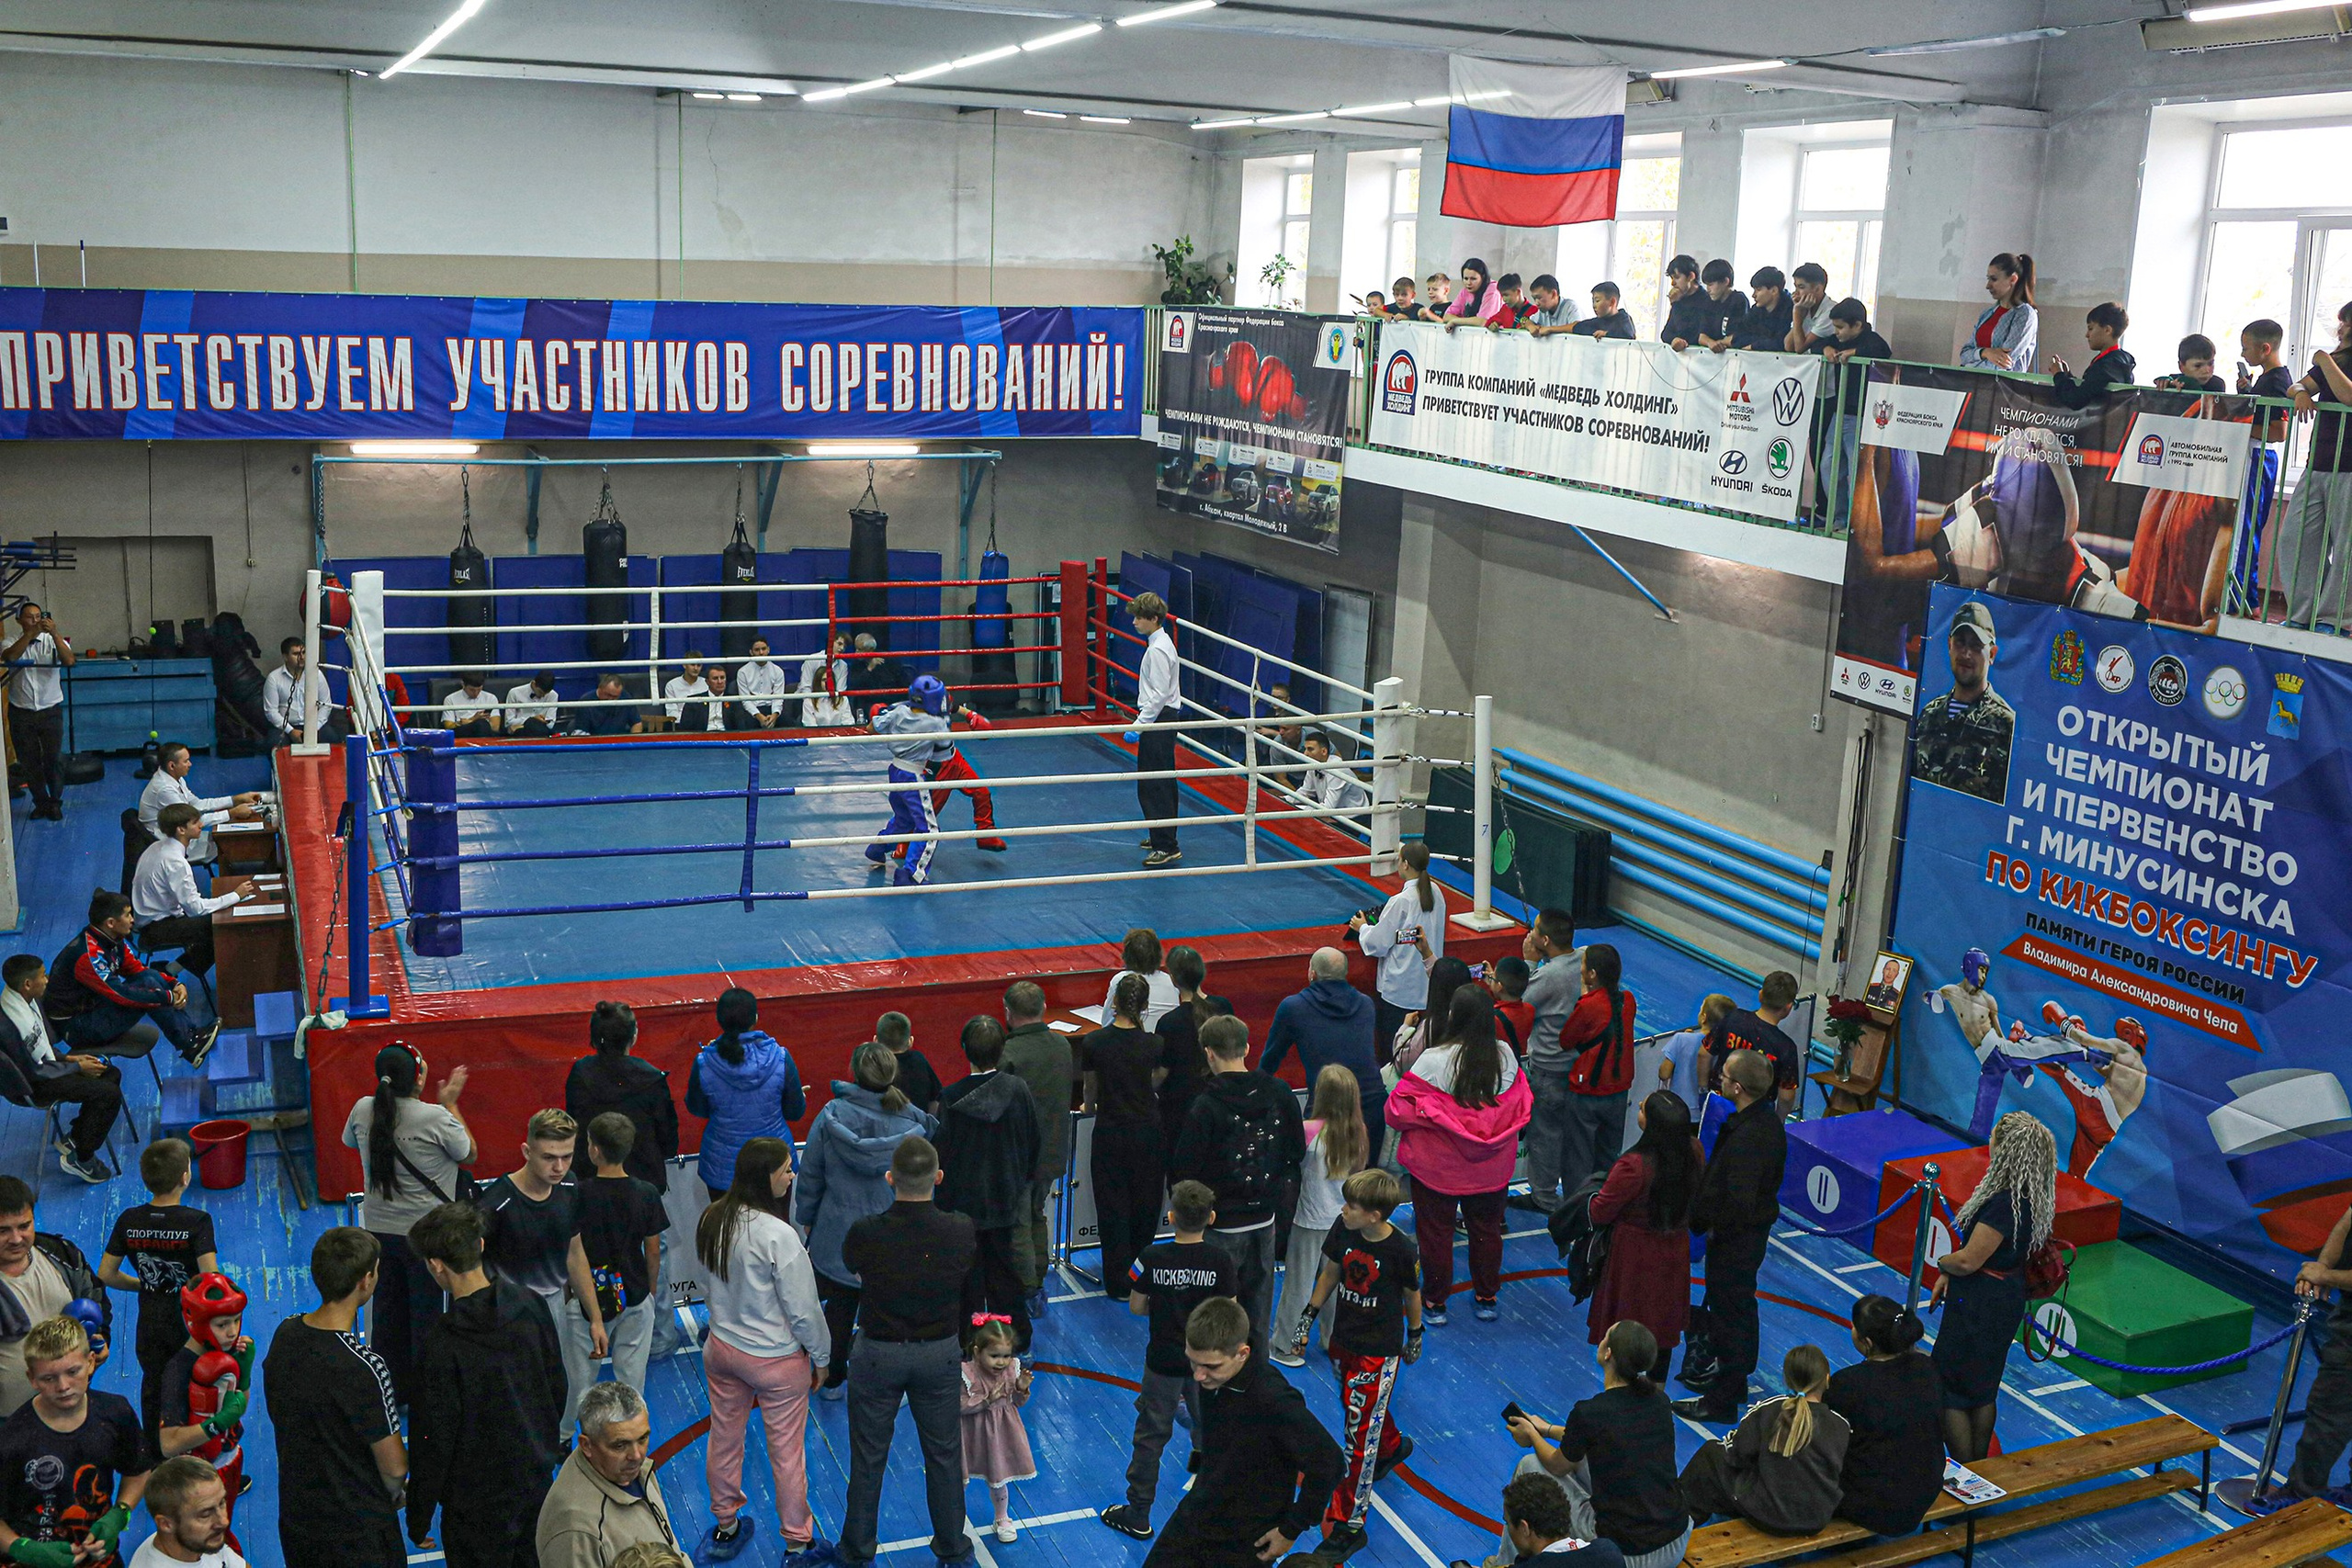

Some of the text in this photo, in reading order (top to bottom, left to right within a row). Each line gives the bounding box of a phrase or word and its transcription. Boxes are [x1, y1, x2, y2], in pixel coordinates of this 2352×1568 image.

[0, 331, 1126, 413] ПРИВЕТСТВУЕМ УЧАСТНИКОВ СОРЕВНОВАНИЙ!
[1425, 369, 1679, 415] ГРУППА КОМПАНИЙ «МЕДВЕДЬ ХОЛДИНГ»
[1725, 404, 1755, 415] MITSUBISHI
[1729, 413, 1751, 423] MOTORS
[1897, 411, 1922, 419] ФЕДЕРАЦИЯ
[2000, 406, 2080, 428] ЧЕМПИОНАМИ
[1204, 414, 1212, 424] НЕ
[1213, 415, 1251, 434] РОЖДАЮТСЯ,
[1253, 423, 1295, 441] ЧЕМПИОНАМИ
[1296, 430, 1343, 448] СТАНОВЯТСЯ!
[1422, 395, 1711, 454] ПРИВЕТСТВУЕТ УЧАСТНИКОВ СОРЕВНОВАНИЙ!
[1896, 419, 1931, 427] КРАСНОЯРСКОГО
[1994, 424, 2077, 450] НЕ РОЖДАЮТСЯ,
[2014, 446, 2084, 467] СТАНОВЯТСЯ!
[2169, 450, 2228, 463] ГРУППА КОМПАНИЙ
[2171, 442, 2222, 454] АВТОМОБИЛЬНАЯ
[1711, 476, 1753, 492] HYUNDAI
[1761, 483, 1792, 498] ŠKODA
[1875, 689, 1896, 698] HYUNDAI
[2056, 704, 2271, 788] ОТКРЫТЫЙ
[2046, 741, 2275, 833] ЧЕМПИОНАТ
[1482, 824, 1488, 836] 7
[2021, 779, 2300, 888] И ПЕРВЕНСТВО
[2005, 815, 2297, 937] Г. МИНУСИНСКА
[1984, 849, 2320, 990] ПО КИКБОКСИНГУ
[2024, 911, 2246, 1007] ПАМЯТИ ГЕРОЯ РОССИИ
[2022, 941, 2240, 1035] Владимира Александровича Чепа
[127, 1229, 189, 1240] СПОРТКЛУБ
[669, 1280, 697, 1293] УГА
[1152, 1268, 1216, 1286] KICKBOXING
